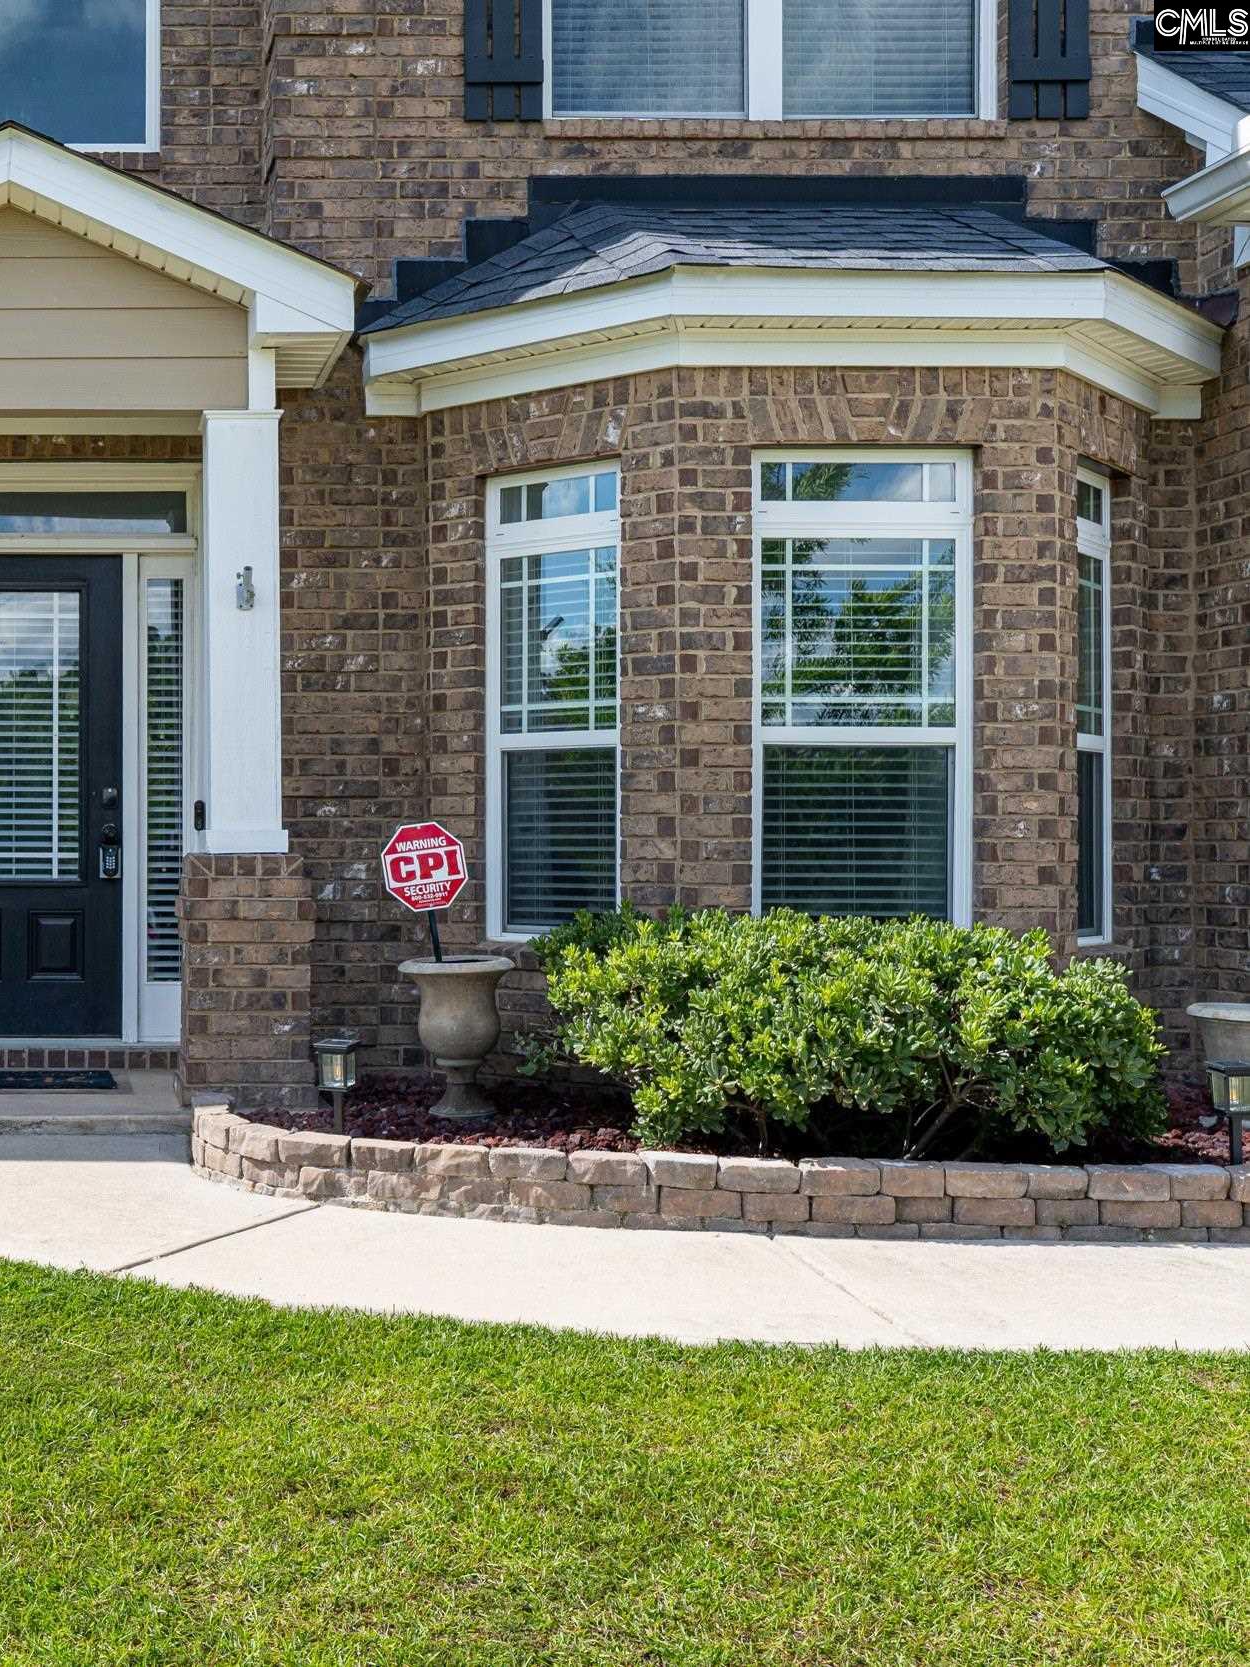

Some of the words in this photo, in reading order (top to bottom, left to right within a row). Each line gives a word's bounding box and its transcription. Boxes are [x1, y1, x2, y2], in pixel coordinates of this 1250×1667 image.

[395, 836, 446, 852] WARNING
[390, 850, 460, 883] CPI
[404, 881, 451, 897] SECURITY
